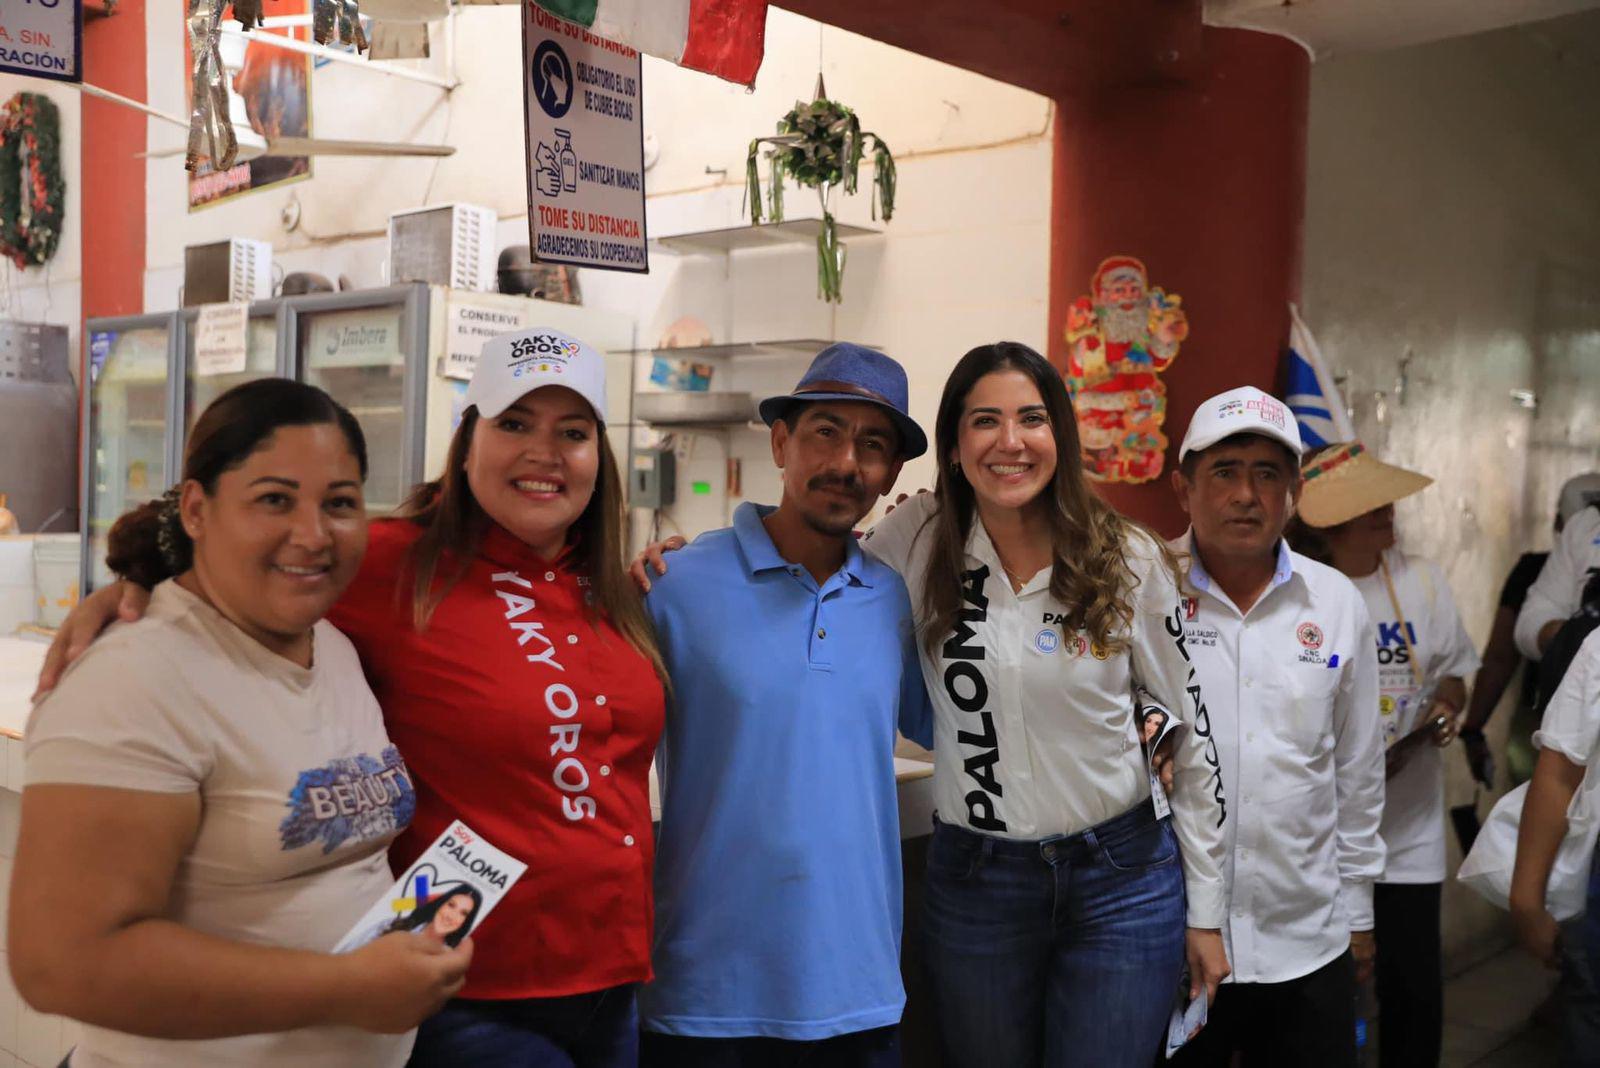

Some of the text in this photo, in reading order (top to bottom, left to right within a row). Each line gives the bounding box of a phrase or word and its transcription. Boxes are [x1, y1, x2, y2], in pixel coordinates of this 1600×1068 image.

[577, 62, 636, 97] OBLIGATORIO EL USO
[584, 90, 633, 121] DE CUBRE BOCAS
[579, 161, 640, 191] SANITIZAR MANOS
[538, 205, 640, 238] TOME SU DISTANCIA
[537, 233, 589, 258] AGRADECEMOS
[590, 240, 599, 260] SU
[458, 326, 468, 335] EL
[459, 308, 520, 326] CONSERVE
[511, 335, 558, 349] YAKY
[511, 343, 562, 359] OROS
[1039, 634, 1056, 648] PAN
[1375, 621, 1418, 647] KI
[1298, 655, 1327, 664] SINALOA
[491, 571, 597, 822] YAKY OROS
[942, 564, 1008, 832] PALOMA
[307, 761, 414, 820] BEAUTY
[439, 836, 510, 890] PALOMA
